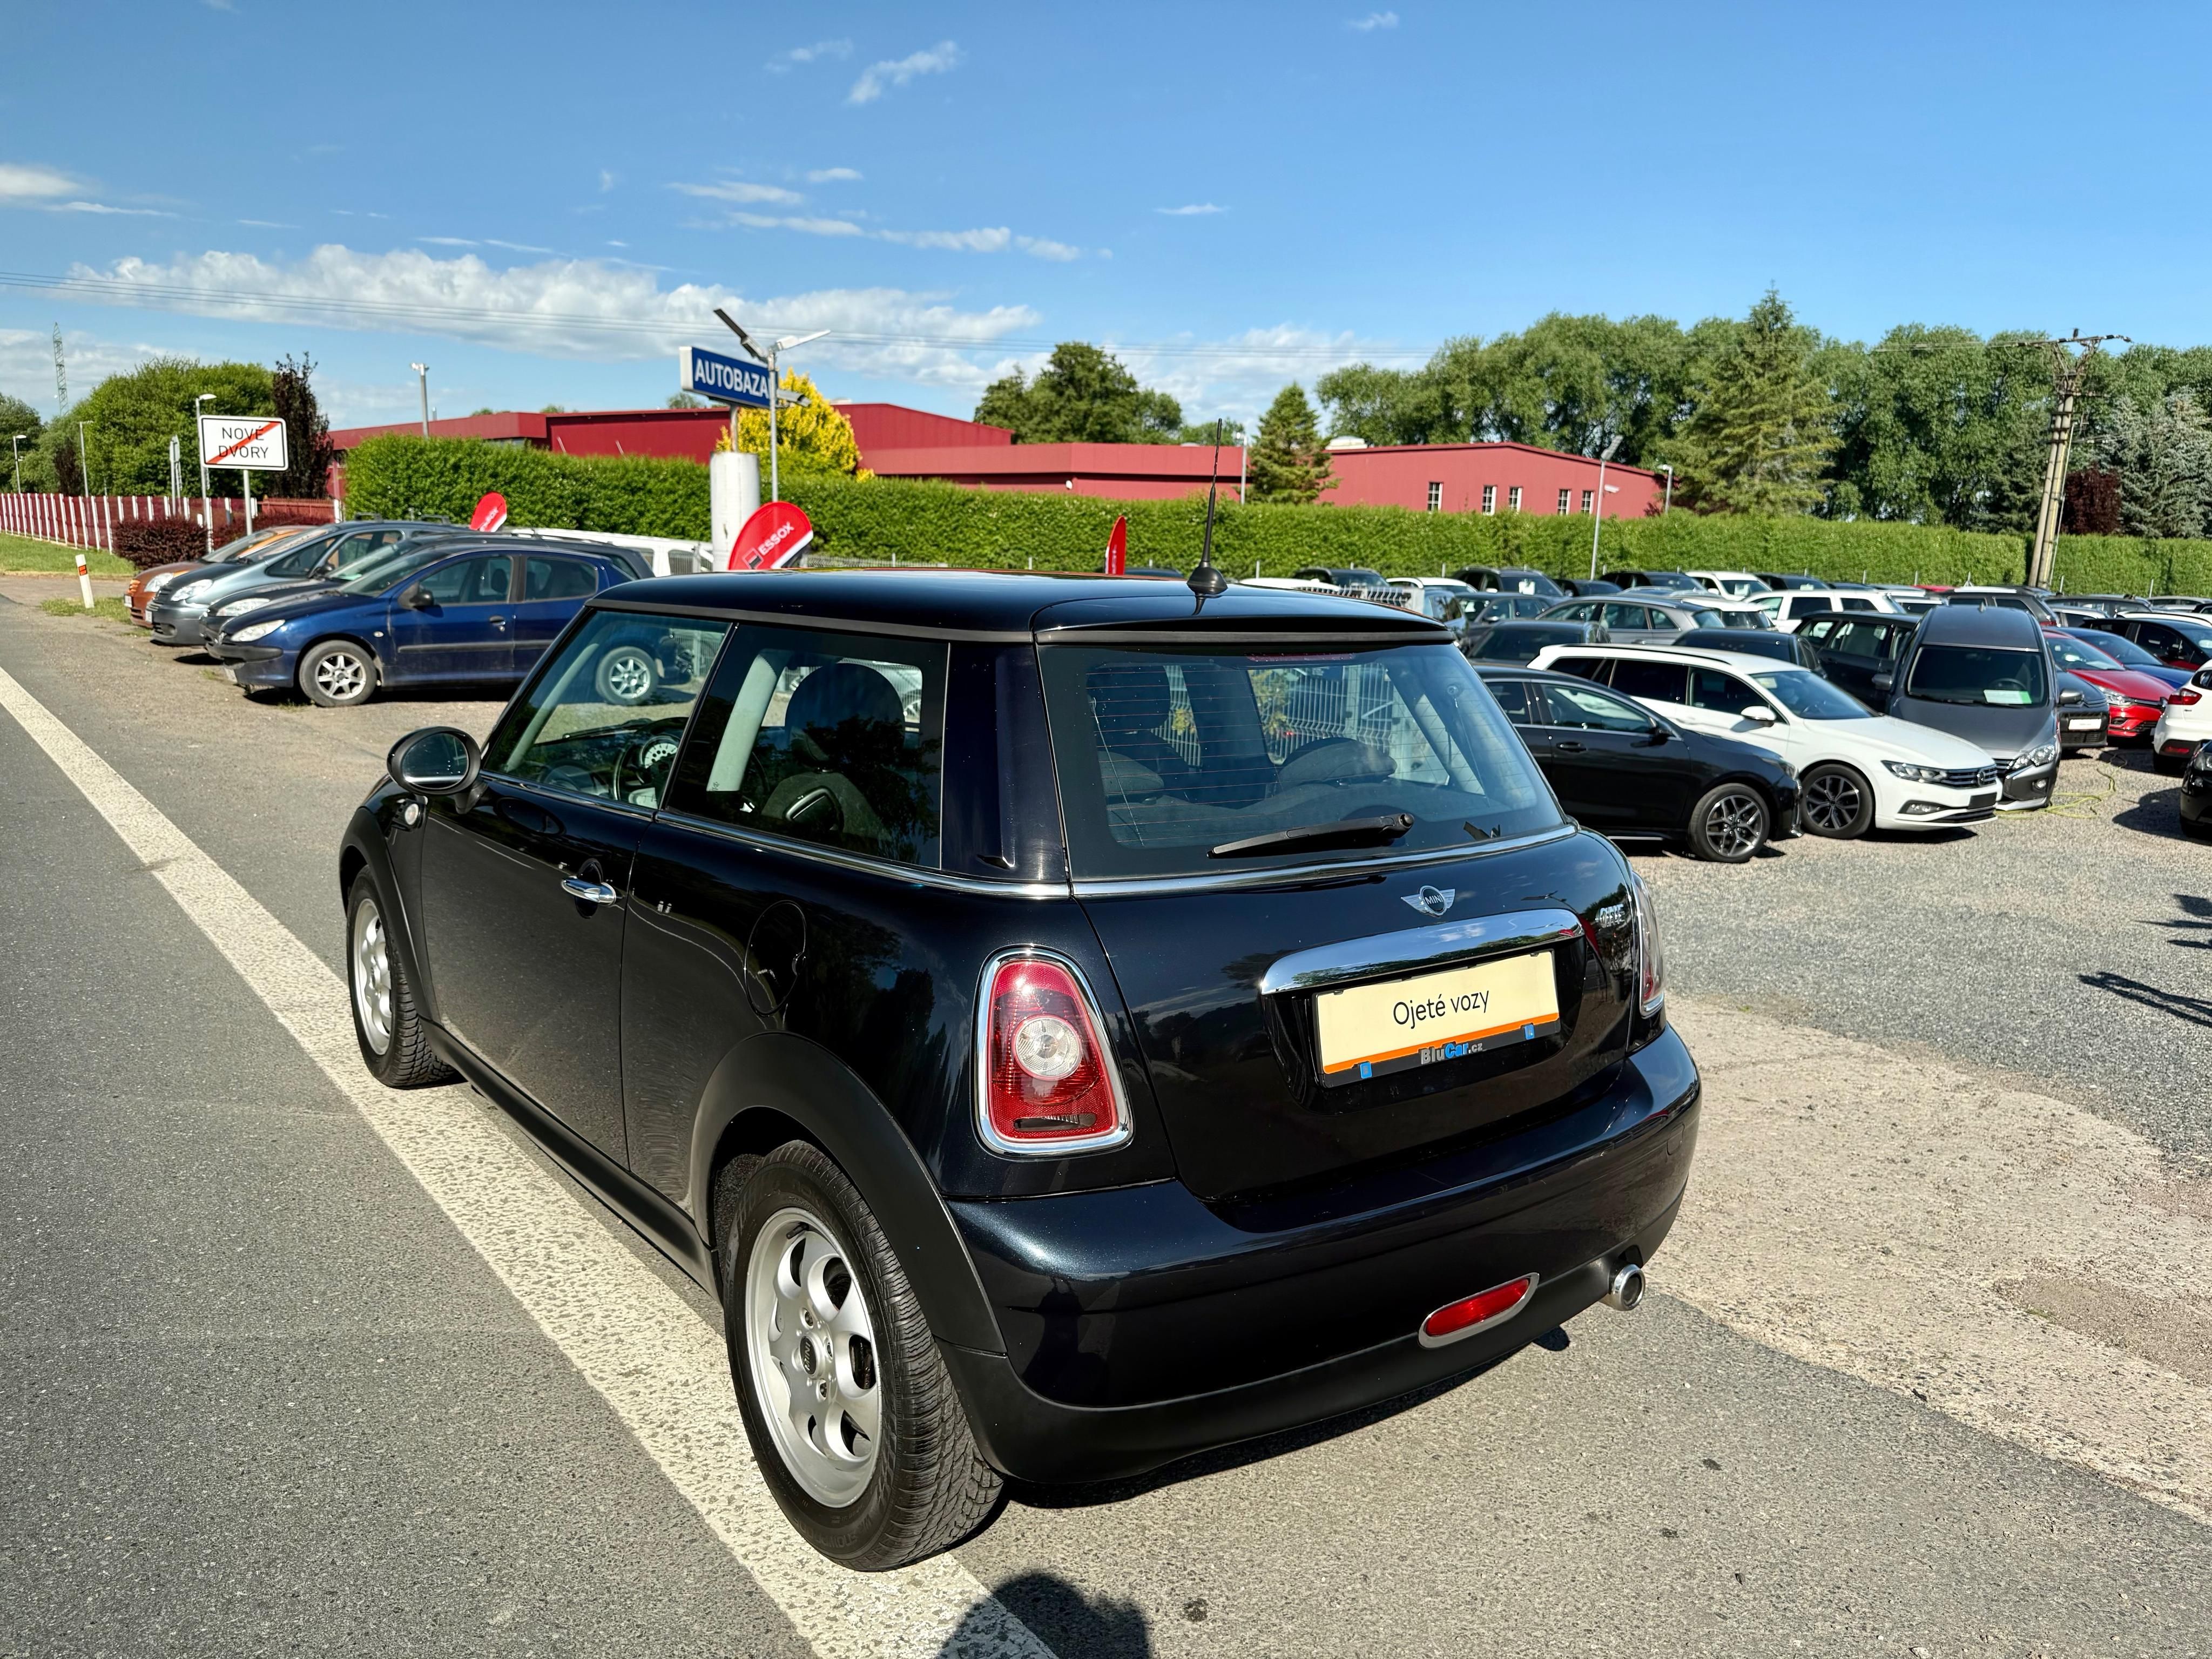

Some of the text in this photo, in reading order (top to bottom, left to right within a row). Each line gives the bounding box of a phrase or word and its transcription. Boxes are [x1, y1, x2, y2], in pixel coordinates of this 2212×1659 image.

[694, 358, 770, 399] AUTOBAZA
[222, 426, 264, 441] NOVÉ
[219, 445, 268, 458] DVORY
[758, 521, 794, 556] ESSOX
[1425, 895, 1444, 905] MINI
[1393, 990, 1489, 1029] Ojeté vozy
[1421, 1043, 1483, 1064] BluCar.cz
